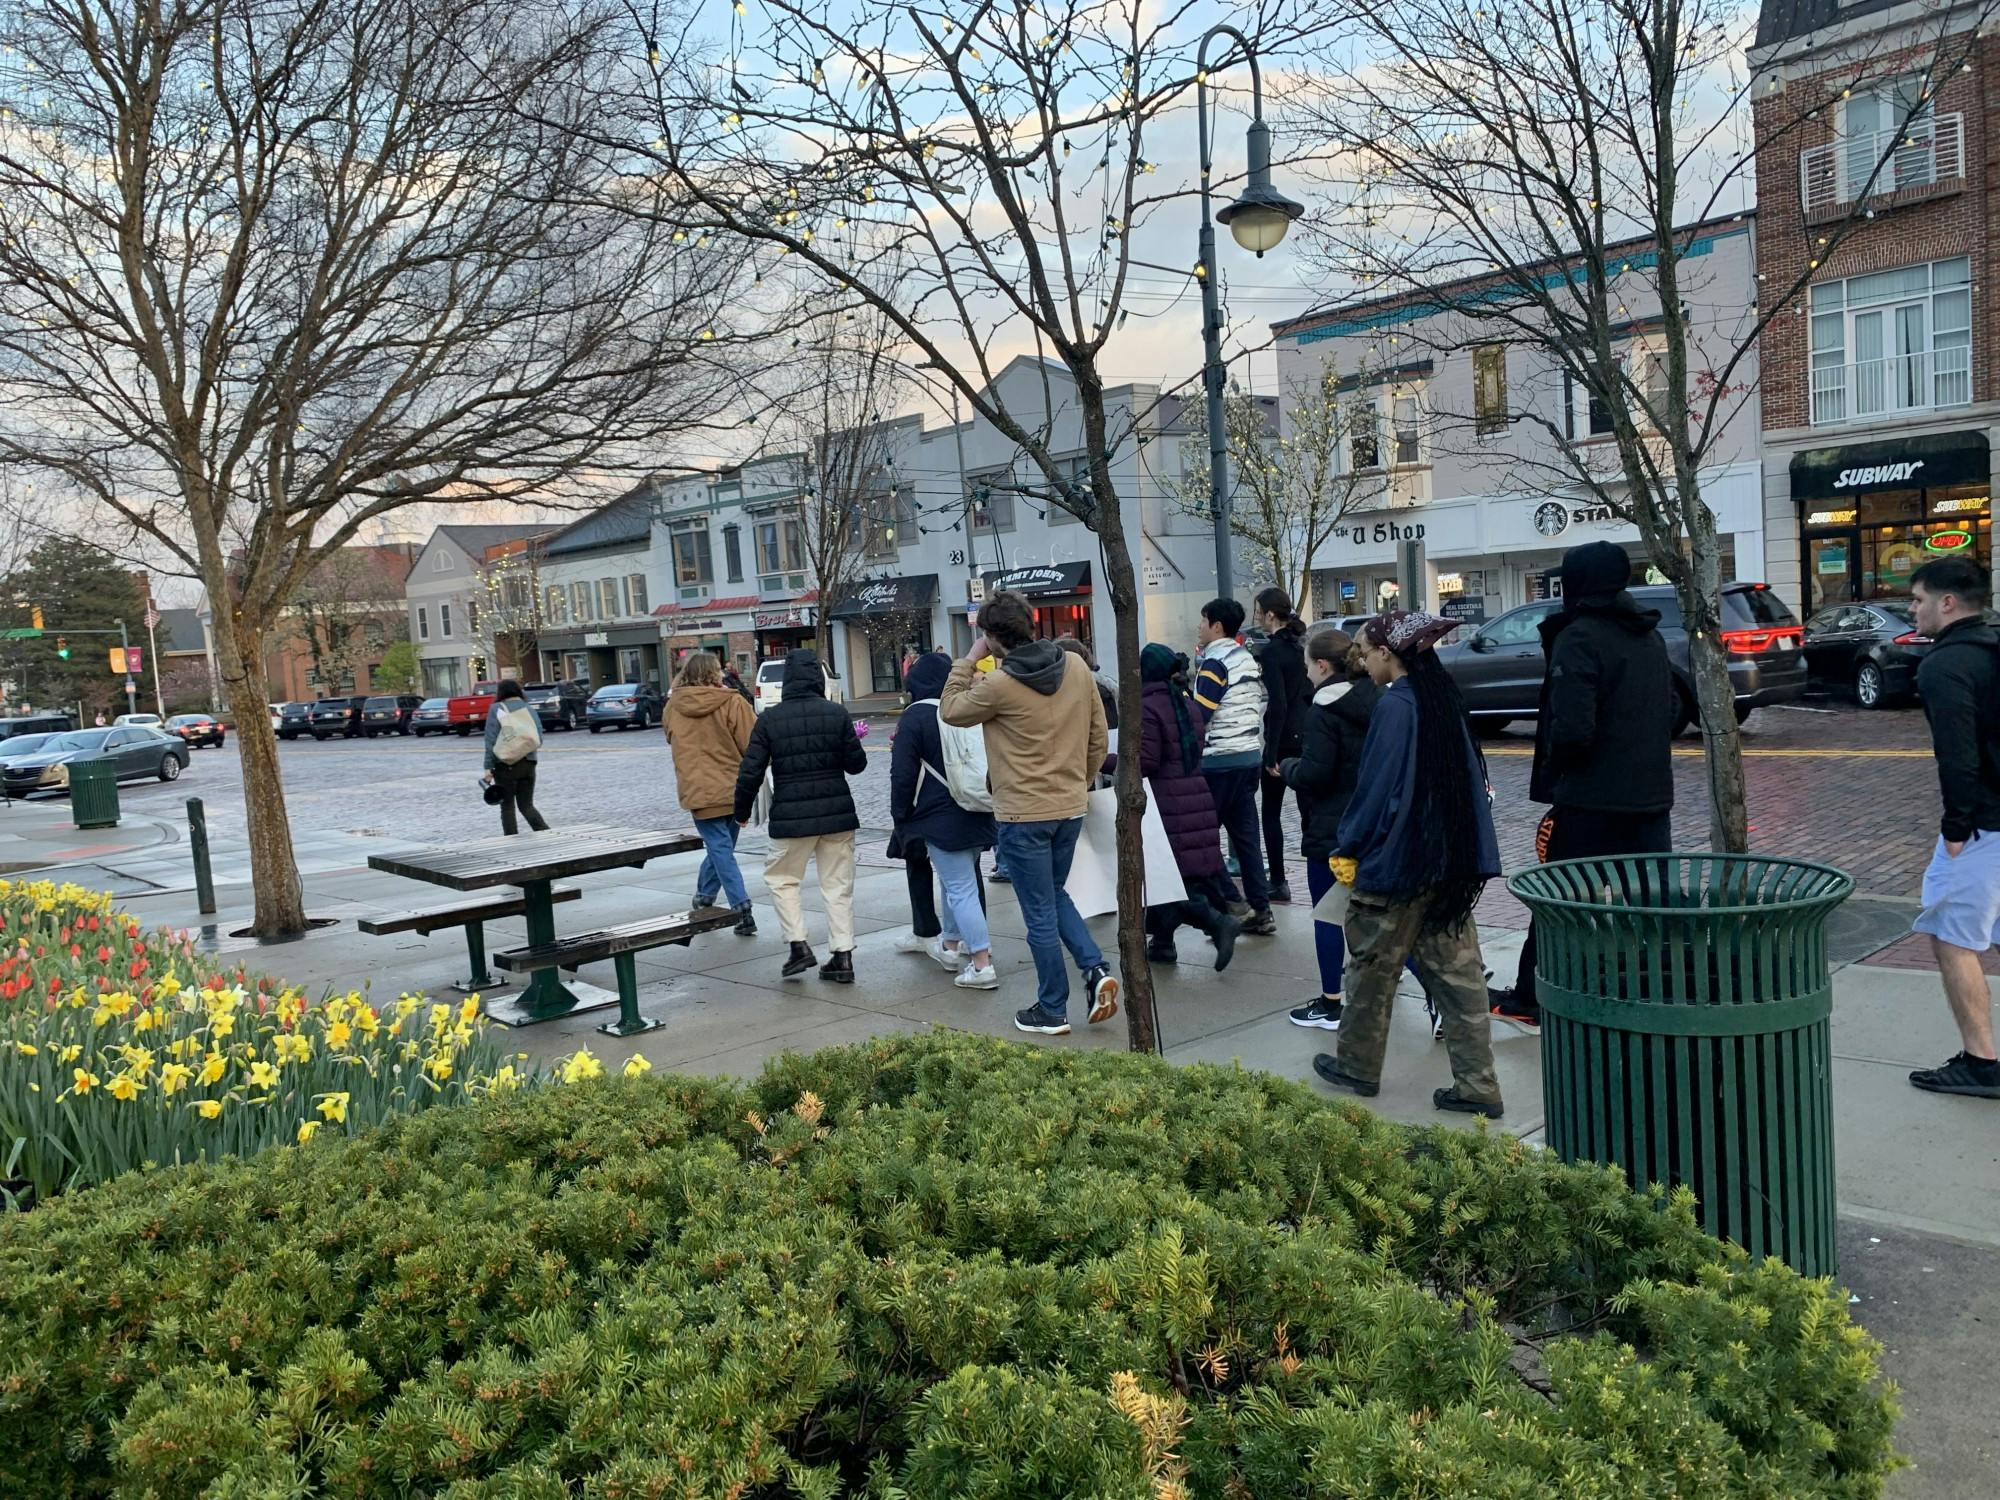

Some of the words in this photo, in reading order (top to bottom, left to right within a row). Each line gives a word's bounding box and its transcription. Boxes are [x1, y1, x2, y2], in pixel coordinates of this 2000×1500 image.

[1833, 460, 1924, 488] SUBWAY
[1374, 521, 1425, 543] Shop
[1931, 536, 1964, 546] OPEN
[949, 550, 964, 565] 23
[1029, 569, 1065, 582] JOHN'S
